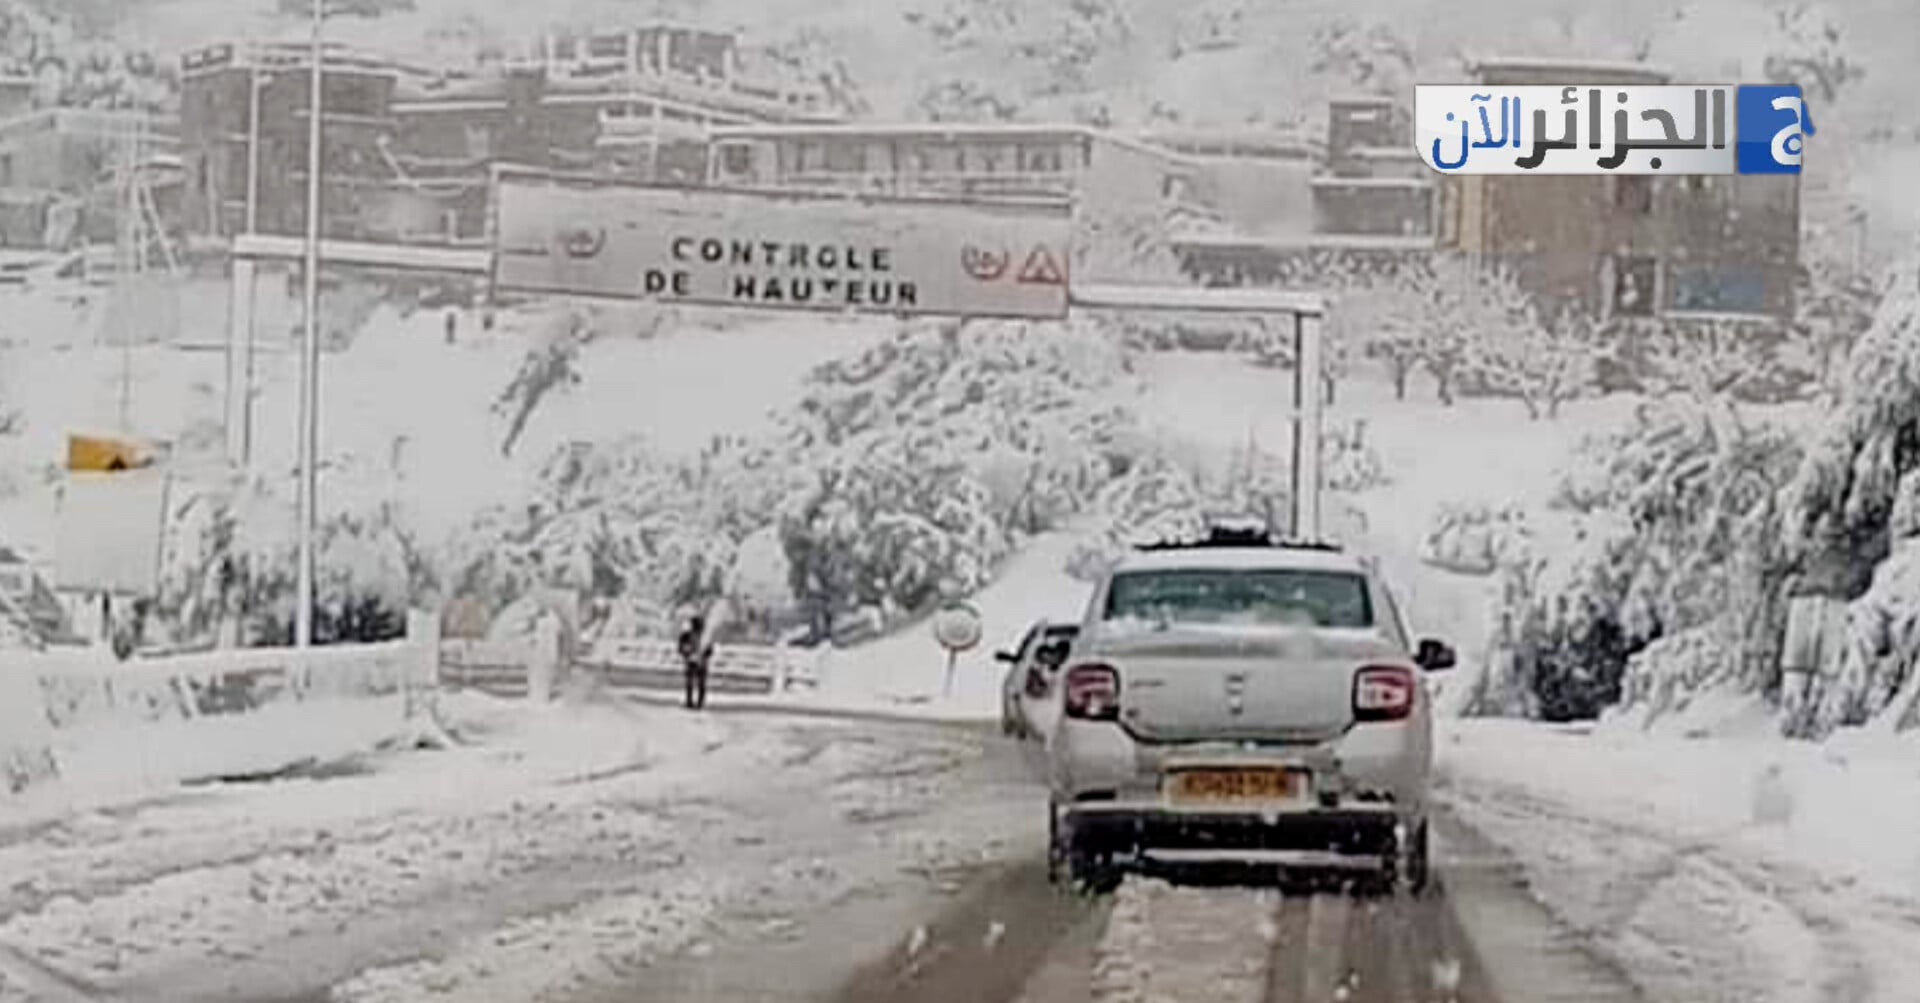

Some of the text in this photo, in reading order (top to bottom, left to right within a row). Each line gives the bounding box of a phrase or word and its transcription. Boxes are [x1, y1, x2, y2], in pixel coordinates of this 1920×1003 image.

[671, 236, 893, 272] CONTROLE
[644, 269, 918, 307] DE HAUTEUR
